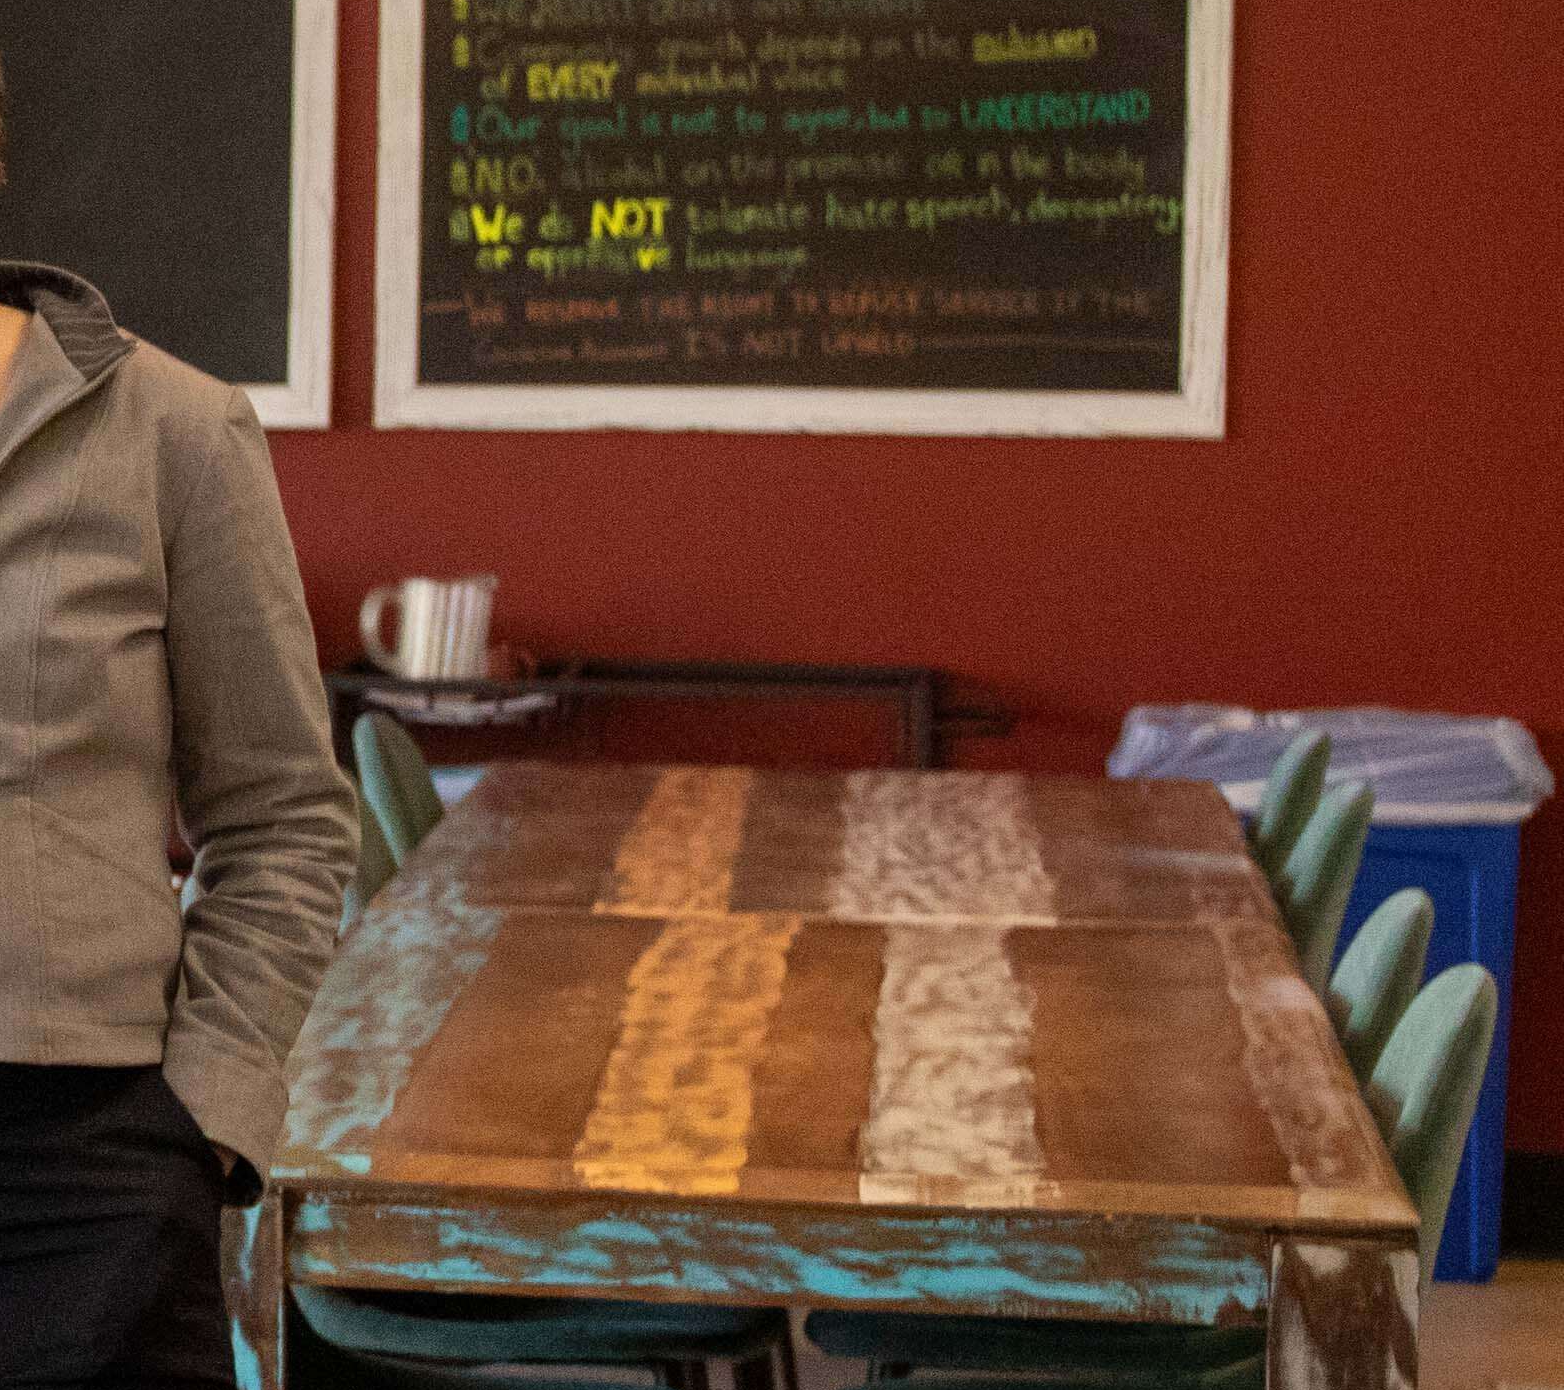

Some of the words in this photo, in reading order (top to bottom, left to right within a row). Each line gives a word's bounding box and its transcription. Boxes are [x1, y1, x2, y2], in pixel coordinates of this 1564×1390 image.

[525, 59, 622, 102] EVERY
[959, 86, 1154, 133] UNDERSTAND
[469, 202, 526, 244] We
[590, 195, 673, 241] NOT
